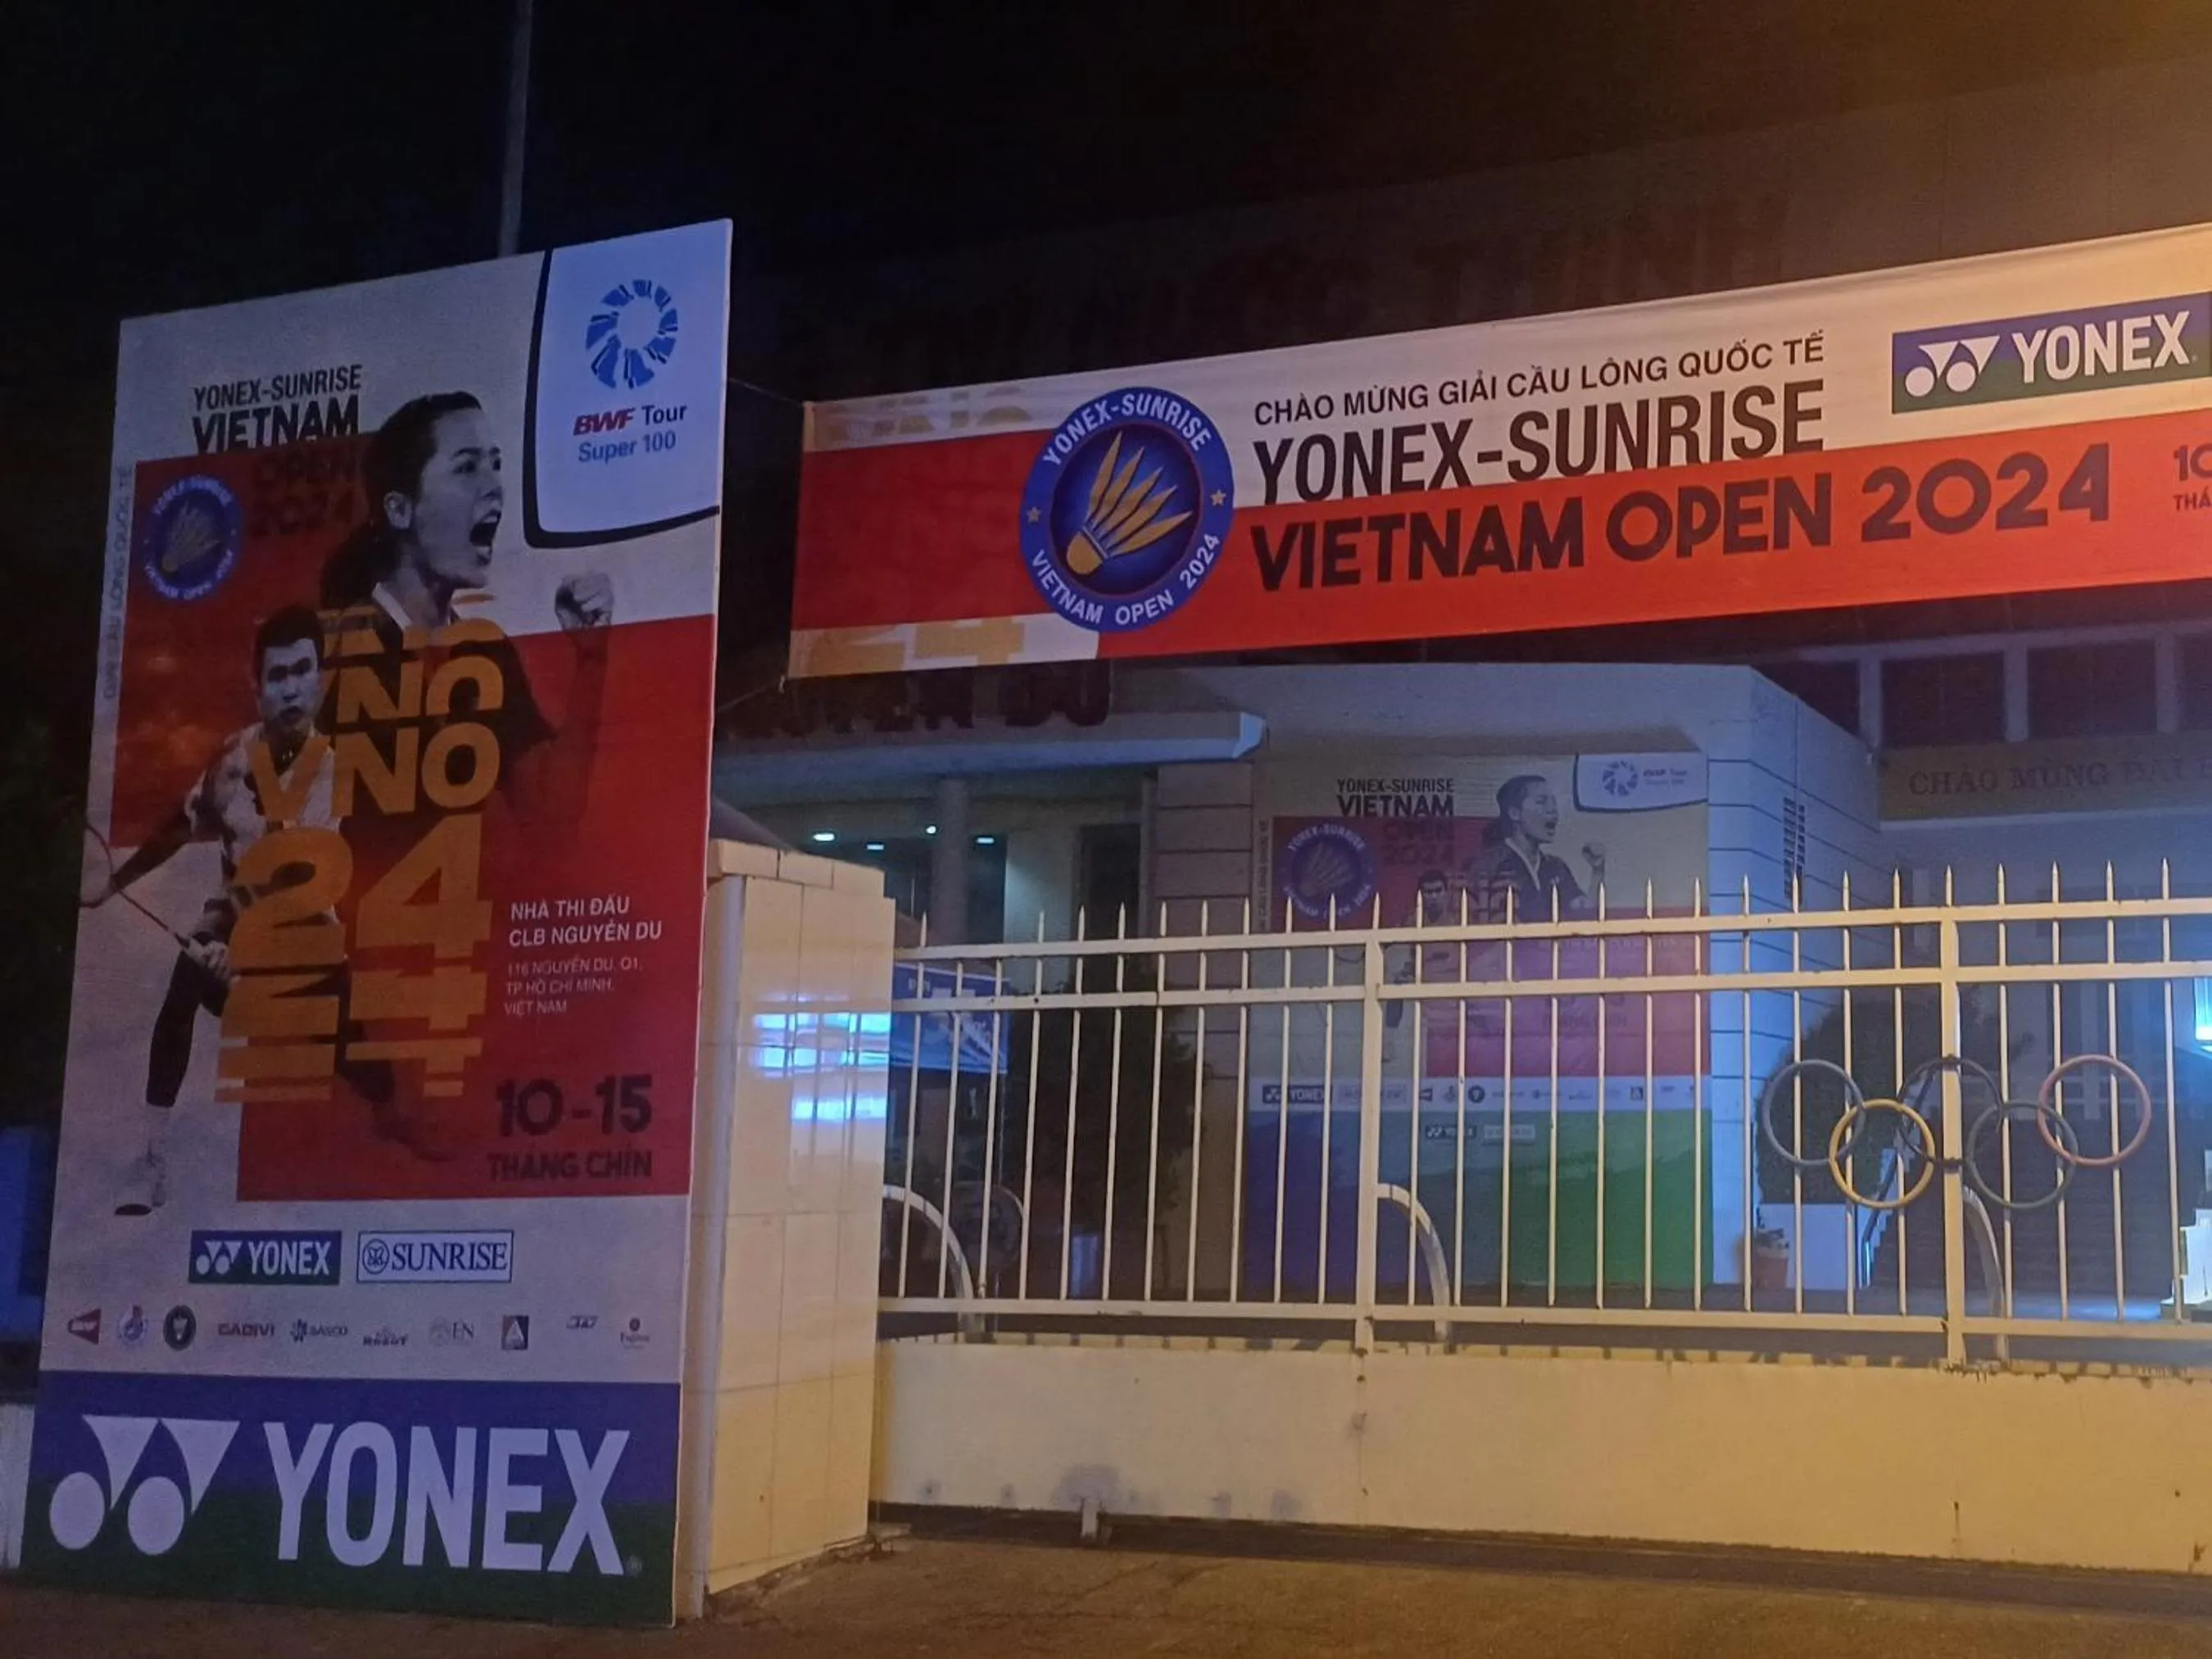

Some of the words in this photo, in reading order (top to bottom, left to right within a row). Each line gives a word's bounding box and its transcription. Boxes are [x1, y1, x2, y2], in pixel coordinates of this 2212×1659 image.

[2012, 310, 2190, 384] YONEX
[190, 363, 363, 412] YONEX-SUNRISE
[1254, 393, 1335, 427] CHÀO
[1344, 378, 1429, 416] MỪNG
[1438, 369, 1497, 406] GIẢI
[1507, 361, 1571, 398] CẦU
[1581, 356, 1667, 391] LÔNG
[1679, 339, 1773, 379] QUỐC
[1783, 329, 1825, 364] TẾ
[191, 393, 359, 454] VIETNAM
[573, 406, 636, 436] BWF
[641, 404, 688, 427] Tour
[1042, 392, 1213, 467] YONEX-SUNRISE
[1253, 378, 1825, 505] YONEX-SUNRISE
[578, 438, 637, 466] Super
[641, 428, 677, 454] 100
[1251, 494, 1584, 592] VIETNAM
[1606, 473, 1832, 563] OPEN
[1861, 442, 2109, 542] 2024
[1031, 548, 1104, 624] VIETNAM
[1114, 588, 1174, 625] OPEN
[1179, 533, 1220, 590] 2024
[1335, 794, 1455, 817] VIETNAM
[1336, 777, 1455, 794] YONEX-SUNRISE
[509, 927, 546, 948] CLB
[635, 920, 662, 941] DU
[511, 897, 550, 922] NHÀ
[555, 898, 585, 918] THI
[248, 1240, 332, 1276] YONEX
[392, 1241, 509, 1272] SUNRISE
[263, 1421, 630, 1575] YONEX
